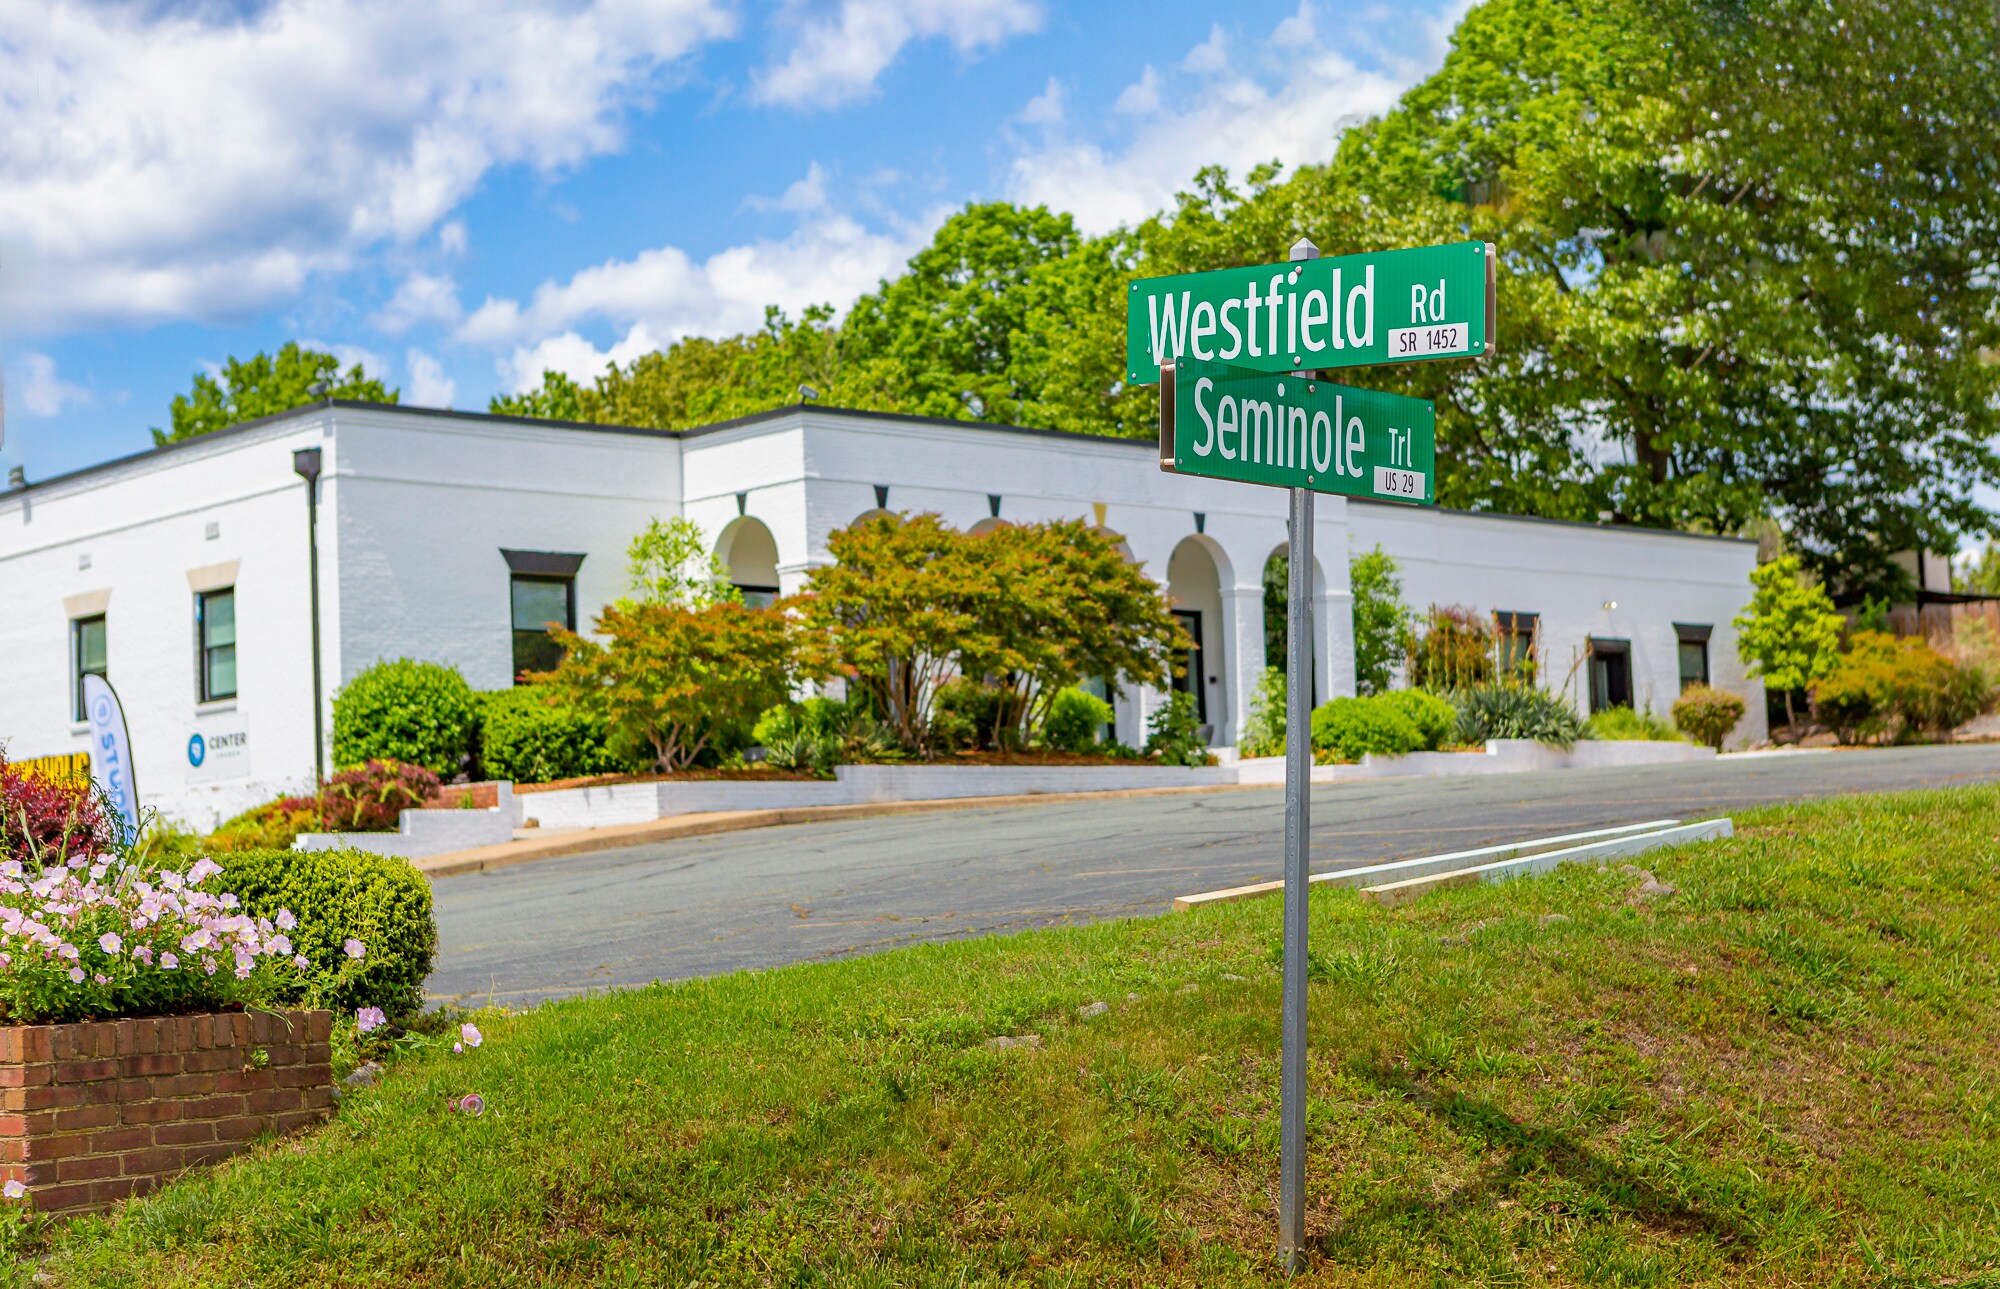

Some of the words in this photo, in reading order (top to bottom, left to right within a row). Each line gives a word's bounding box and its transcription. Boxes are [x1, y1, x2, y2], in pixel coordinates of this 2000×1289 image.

[1147, 264, 1375, 366] Westfield
[1411, 278, 1446, 324] Rd
[1399, 331, 1417, 353] SR
[1426, 327, 1457, 350] 1452
[1192, 376, 1366, 479] Seminole
[1388, 427, 1413, 468] Trl
[1385, 471, 1397, 492] US
[1402, 473, 1414, 494] 29
[208, 731, 247, 750] CENTER
